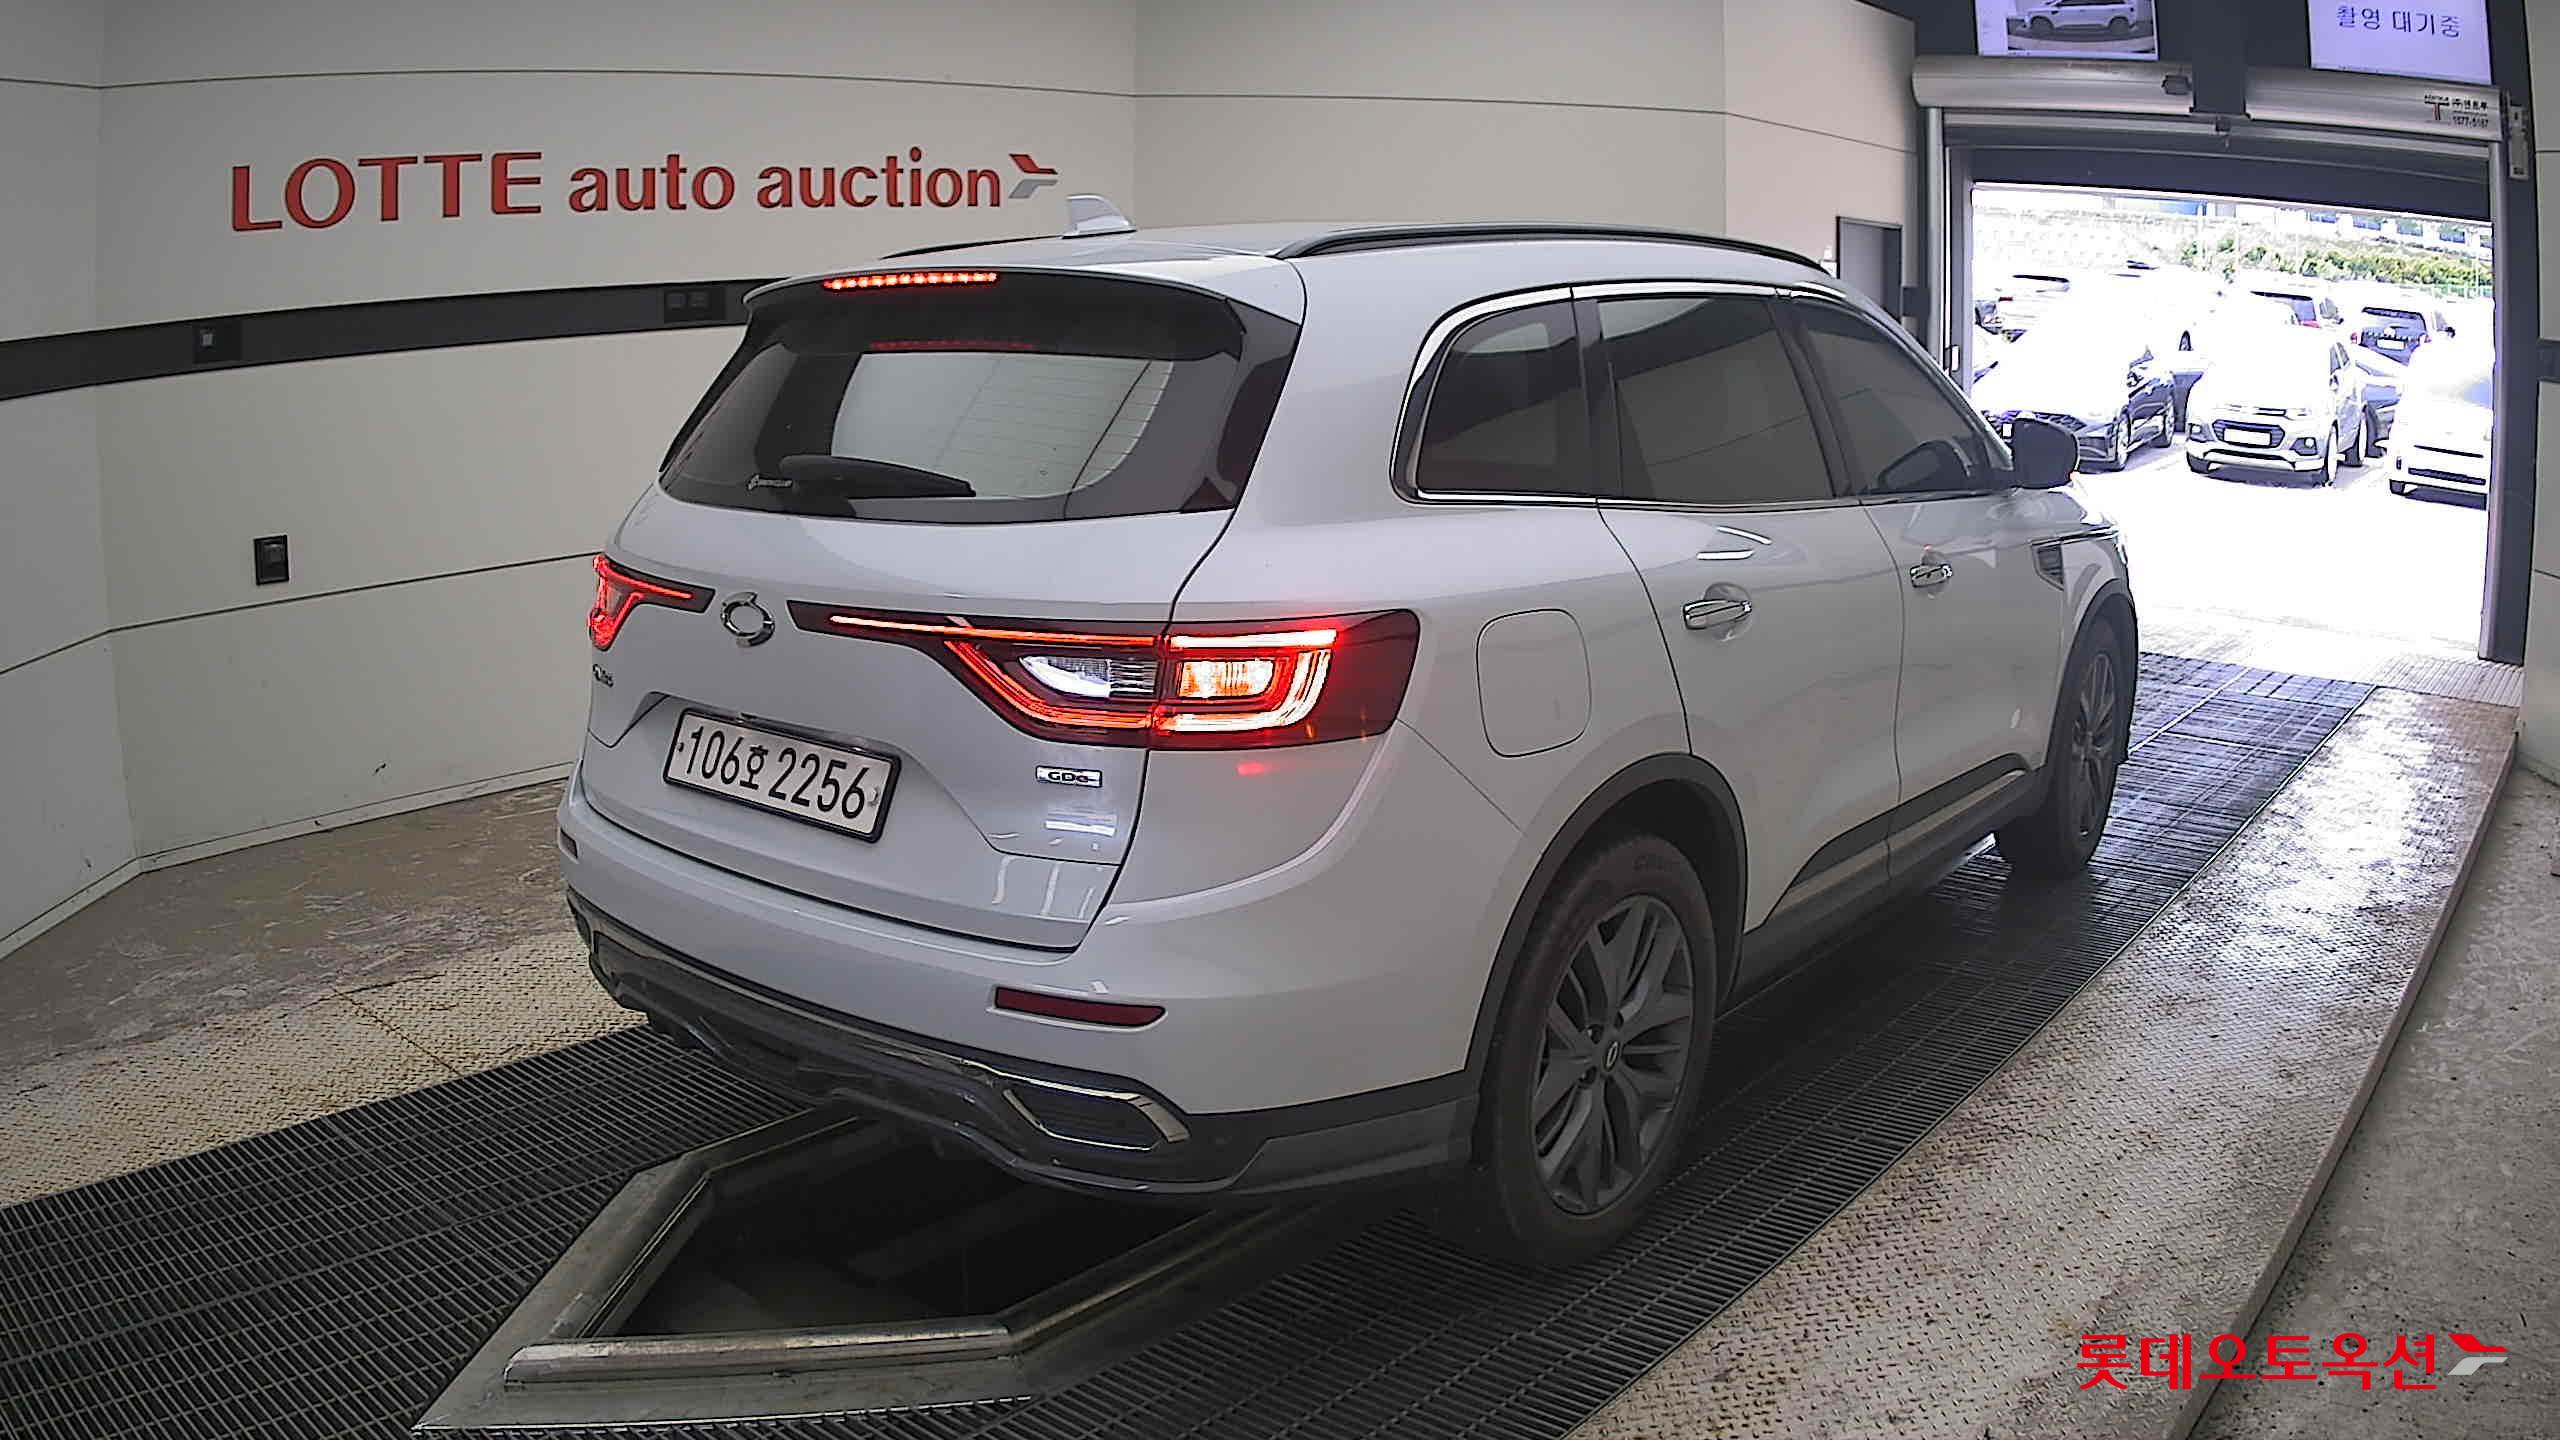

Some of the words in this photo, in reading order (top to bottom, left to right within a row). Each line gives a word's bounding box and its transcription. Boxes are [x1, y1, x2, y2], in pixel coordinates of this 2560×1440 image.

[2337, 5, 2381, 31] 촬영
[2392, 11, 2460, 38] 대기중
[232, 152, 542, 232] LOTTE
[568, 153, 736, 213] auto
[757, 146, 1001, 209] auction
[768, 747, 870, 819] 2256
